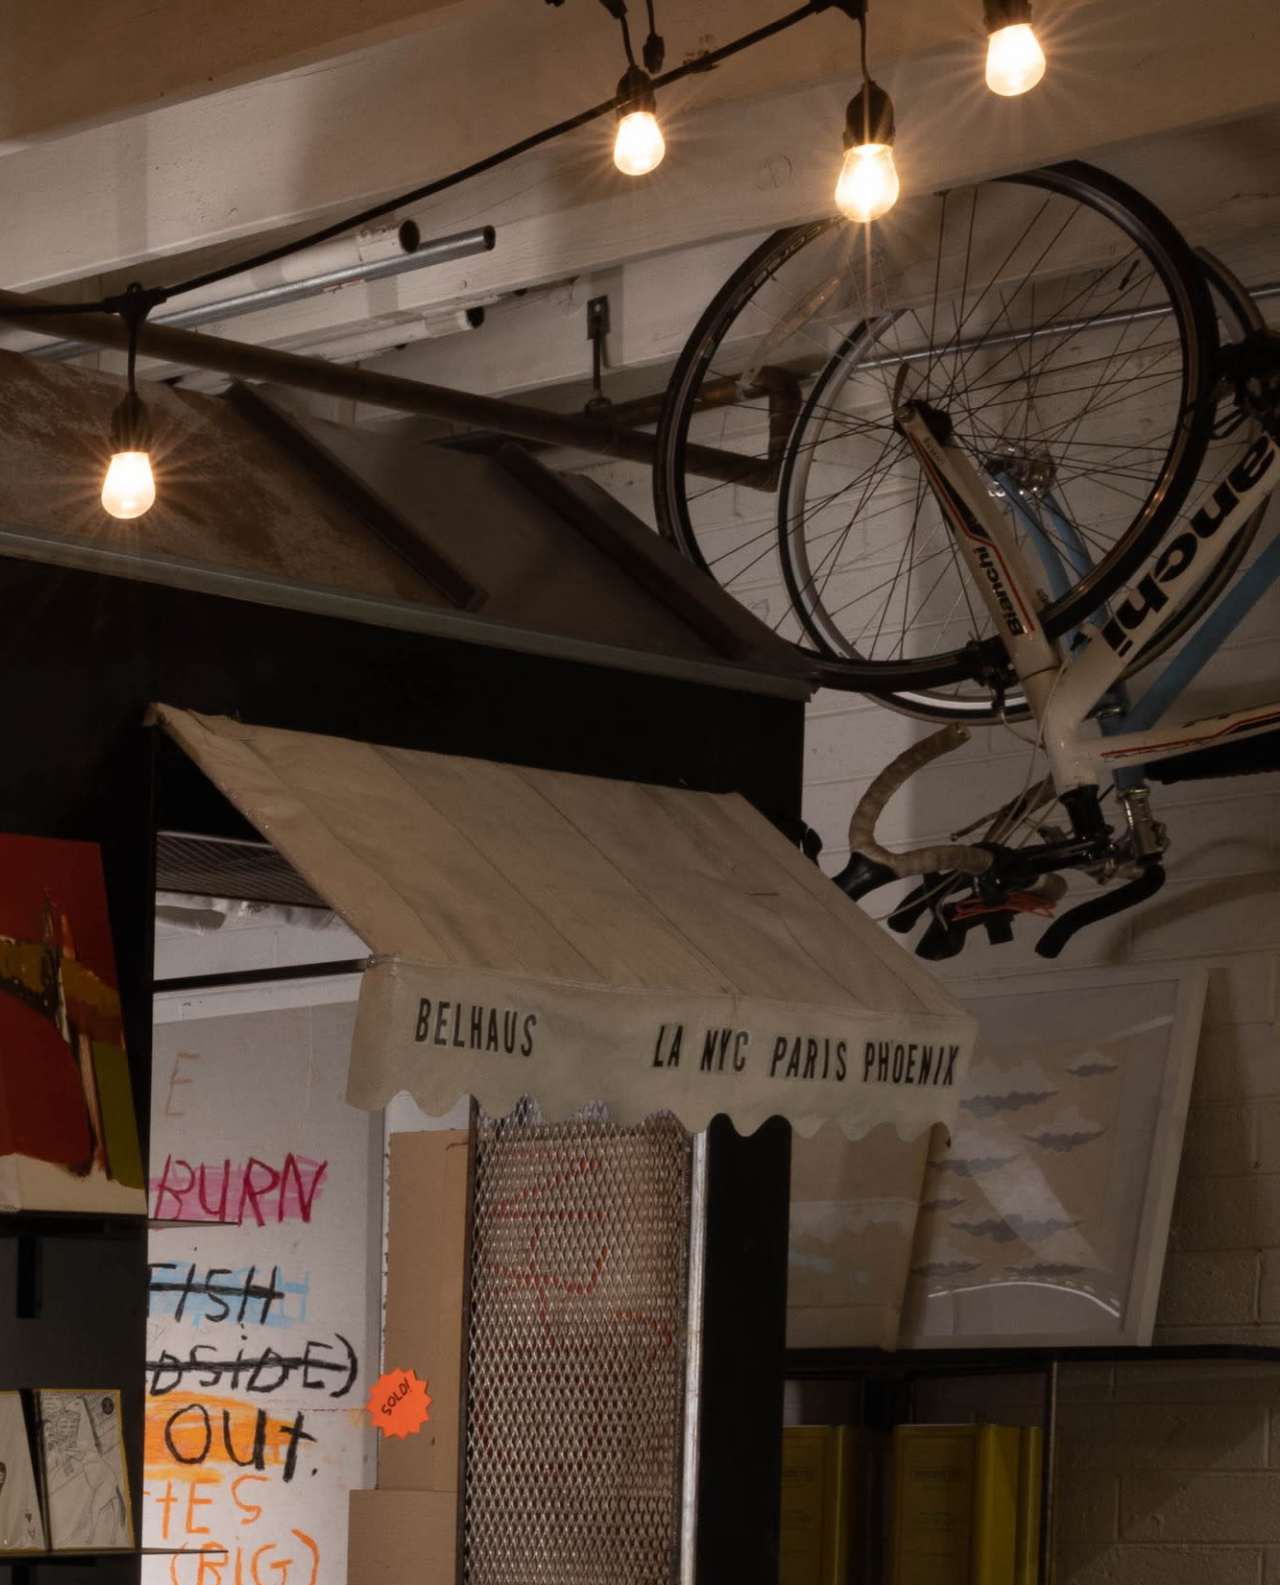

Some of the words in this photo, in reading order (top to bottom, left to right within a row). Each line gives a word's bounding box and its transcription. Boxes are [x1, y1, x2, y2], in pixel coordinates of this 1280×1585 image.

[975, 546, 1026, 636] Bianchi
[414, 997, 538, 1057] BELHAUS
[653, 1022, 683, 1068] LA
[699, 1028, 749, 1074] NYC
[770, 1034, 848, 1083] PARIS
[862, 1040, 960, 1087] PHOENIX
[154, 1152, 328, 1227] BURN
[380, 1379, 411, 1417] SOLD!
